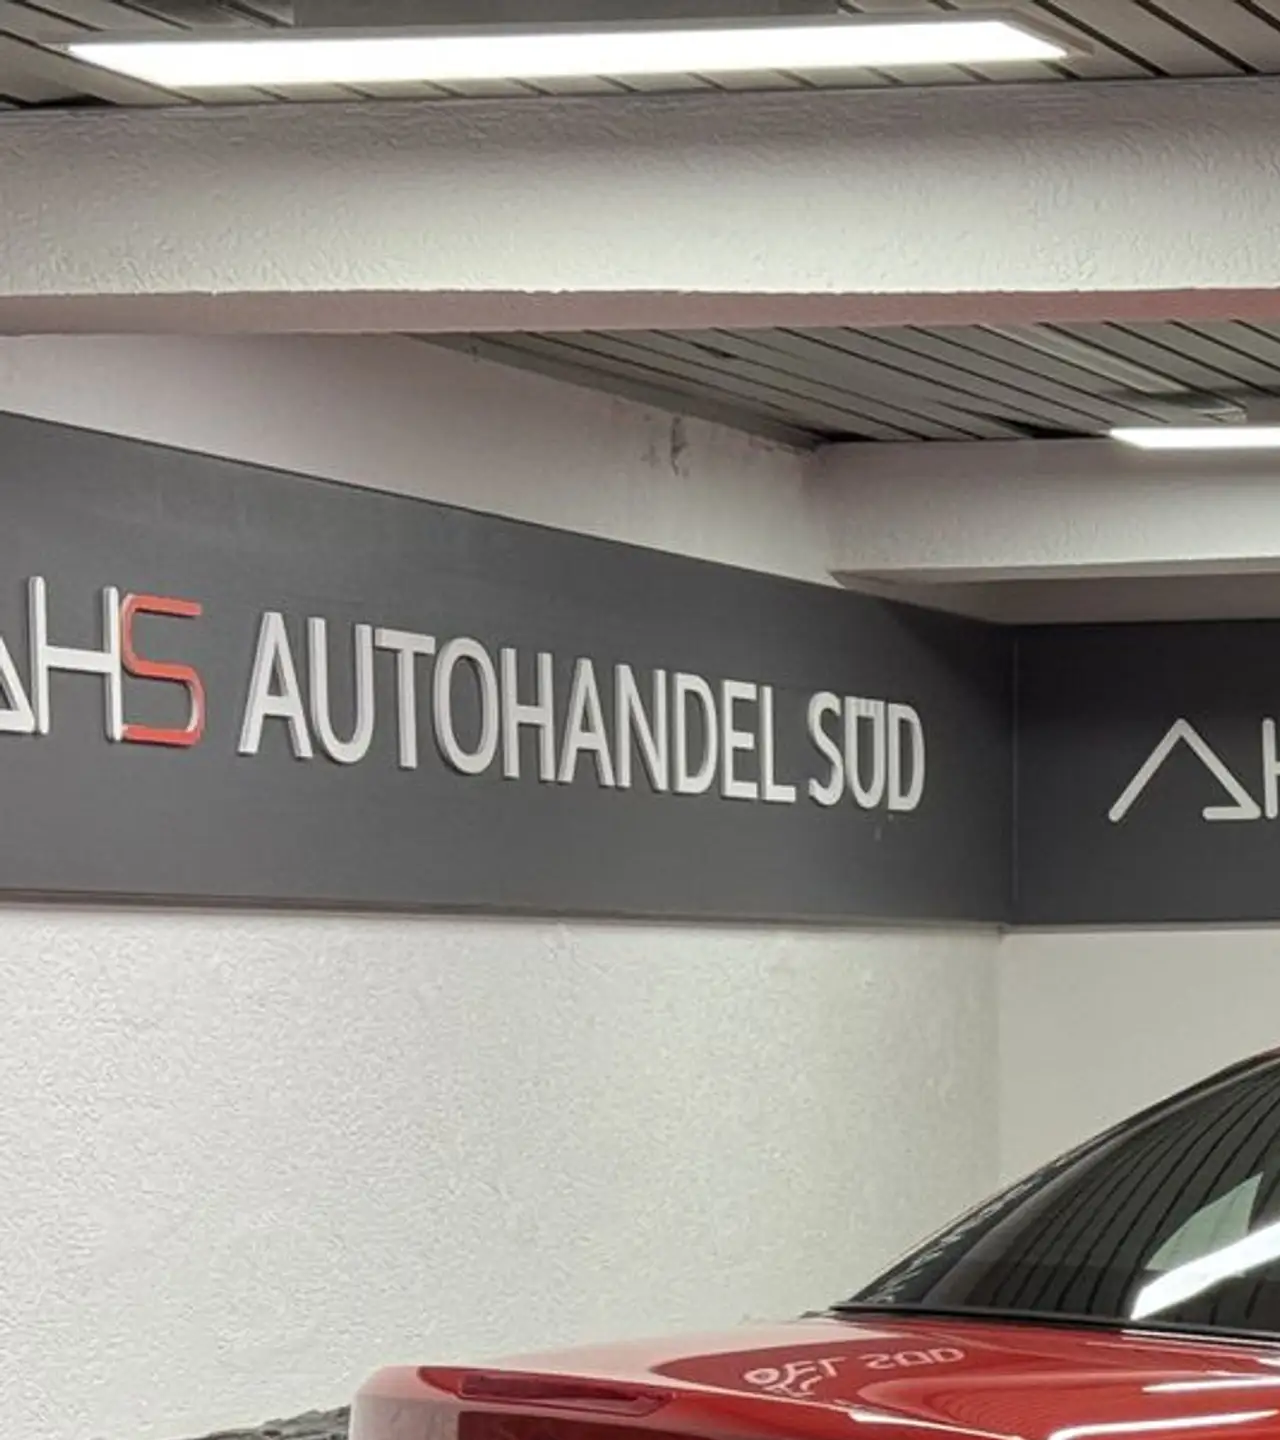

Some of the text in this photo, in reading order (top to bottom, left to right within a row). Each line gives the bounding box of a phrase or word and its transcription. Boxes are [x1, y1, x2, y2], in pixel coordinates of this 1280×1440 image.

[0, 575, 926, 812] HS AUTOHANDEL SÜD
